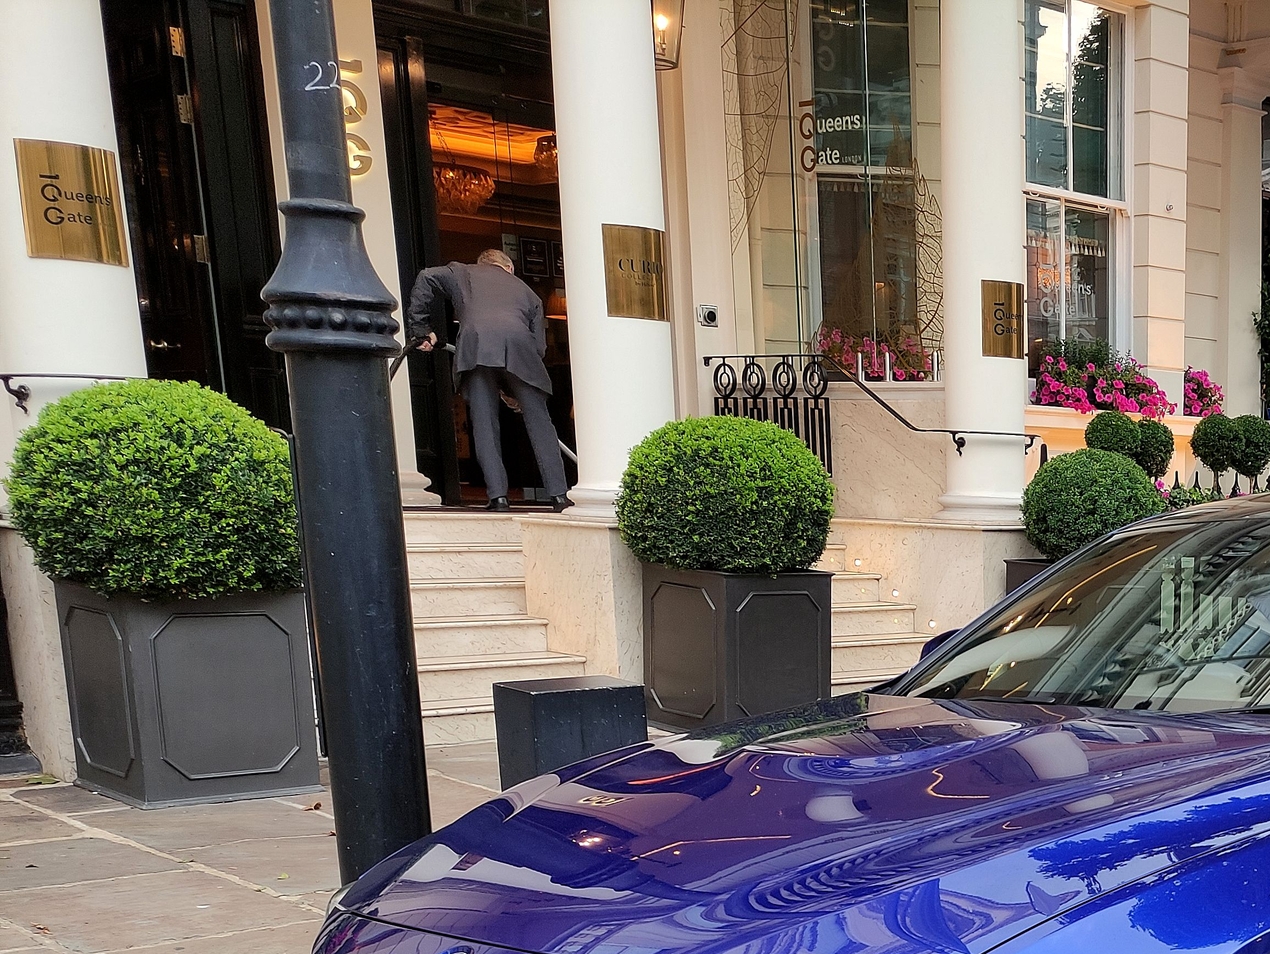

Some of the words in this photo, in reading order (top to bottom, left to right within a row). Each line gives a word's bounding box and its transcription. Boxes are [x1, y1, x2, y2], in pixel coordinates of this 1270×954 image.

[304, 61, 341, 91] 22
[800, 112, 861, 140] Queen's
[801, 145, 840, 172] Gate
[41, 183, 111, 206] Queen's
[43, 206, 93, 225] Gate
[994, 323, 1018, 336] Gate
